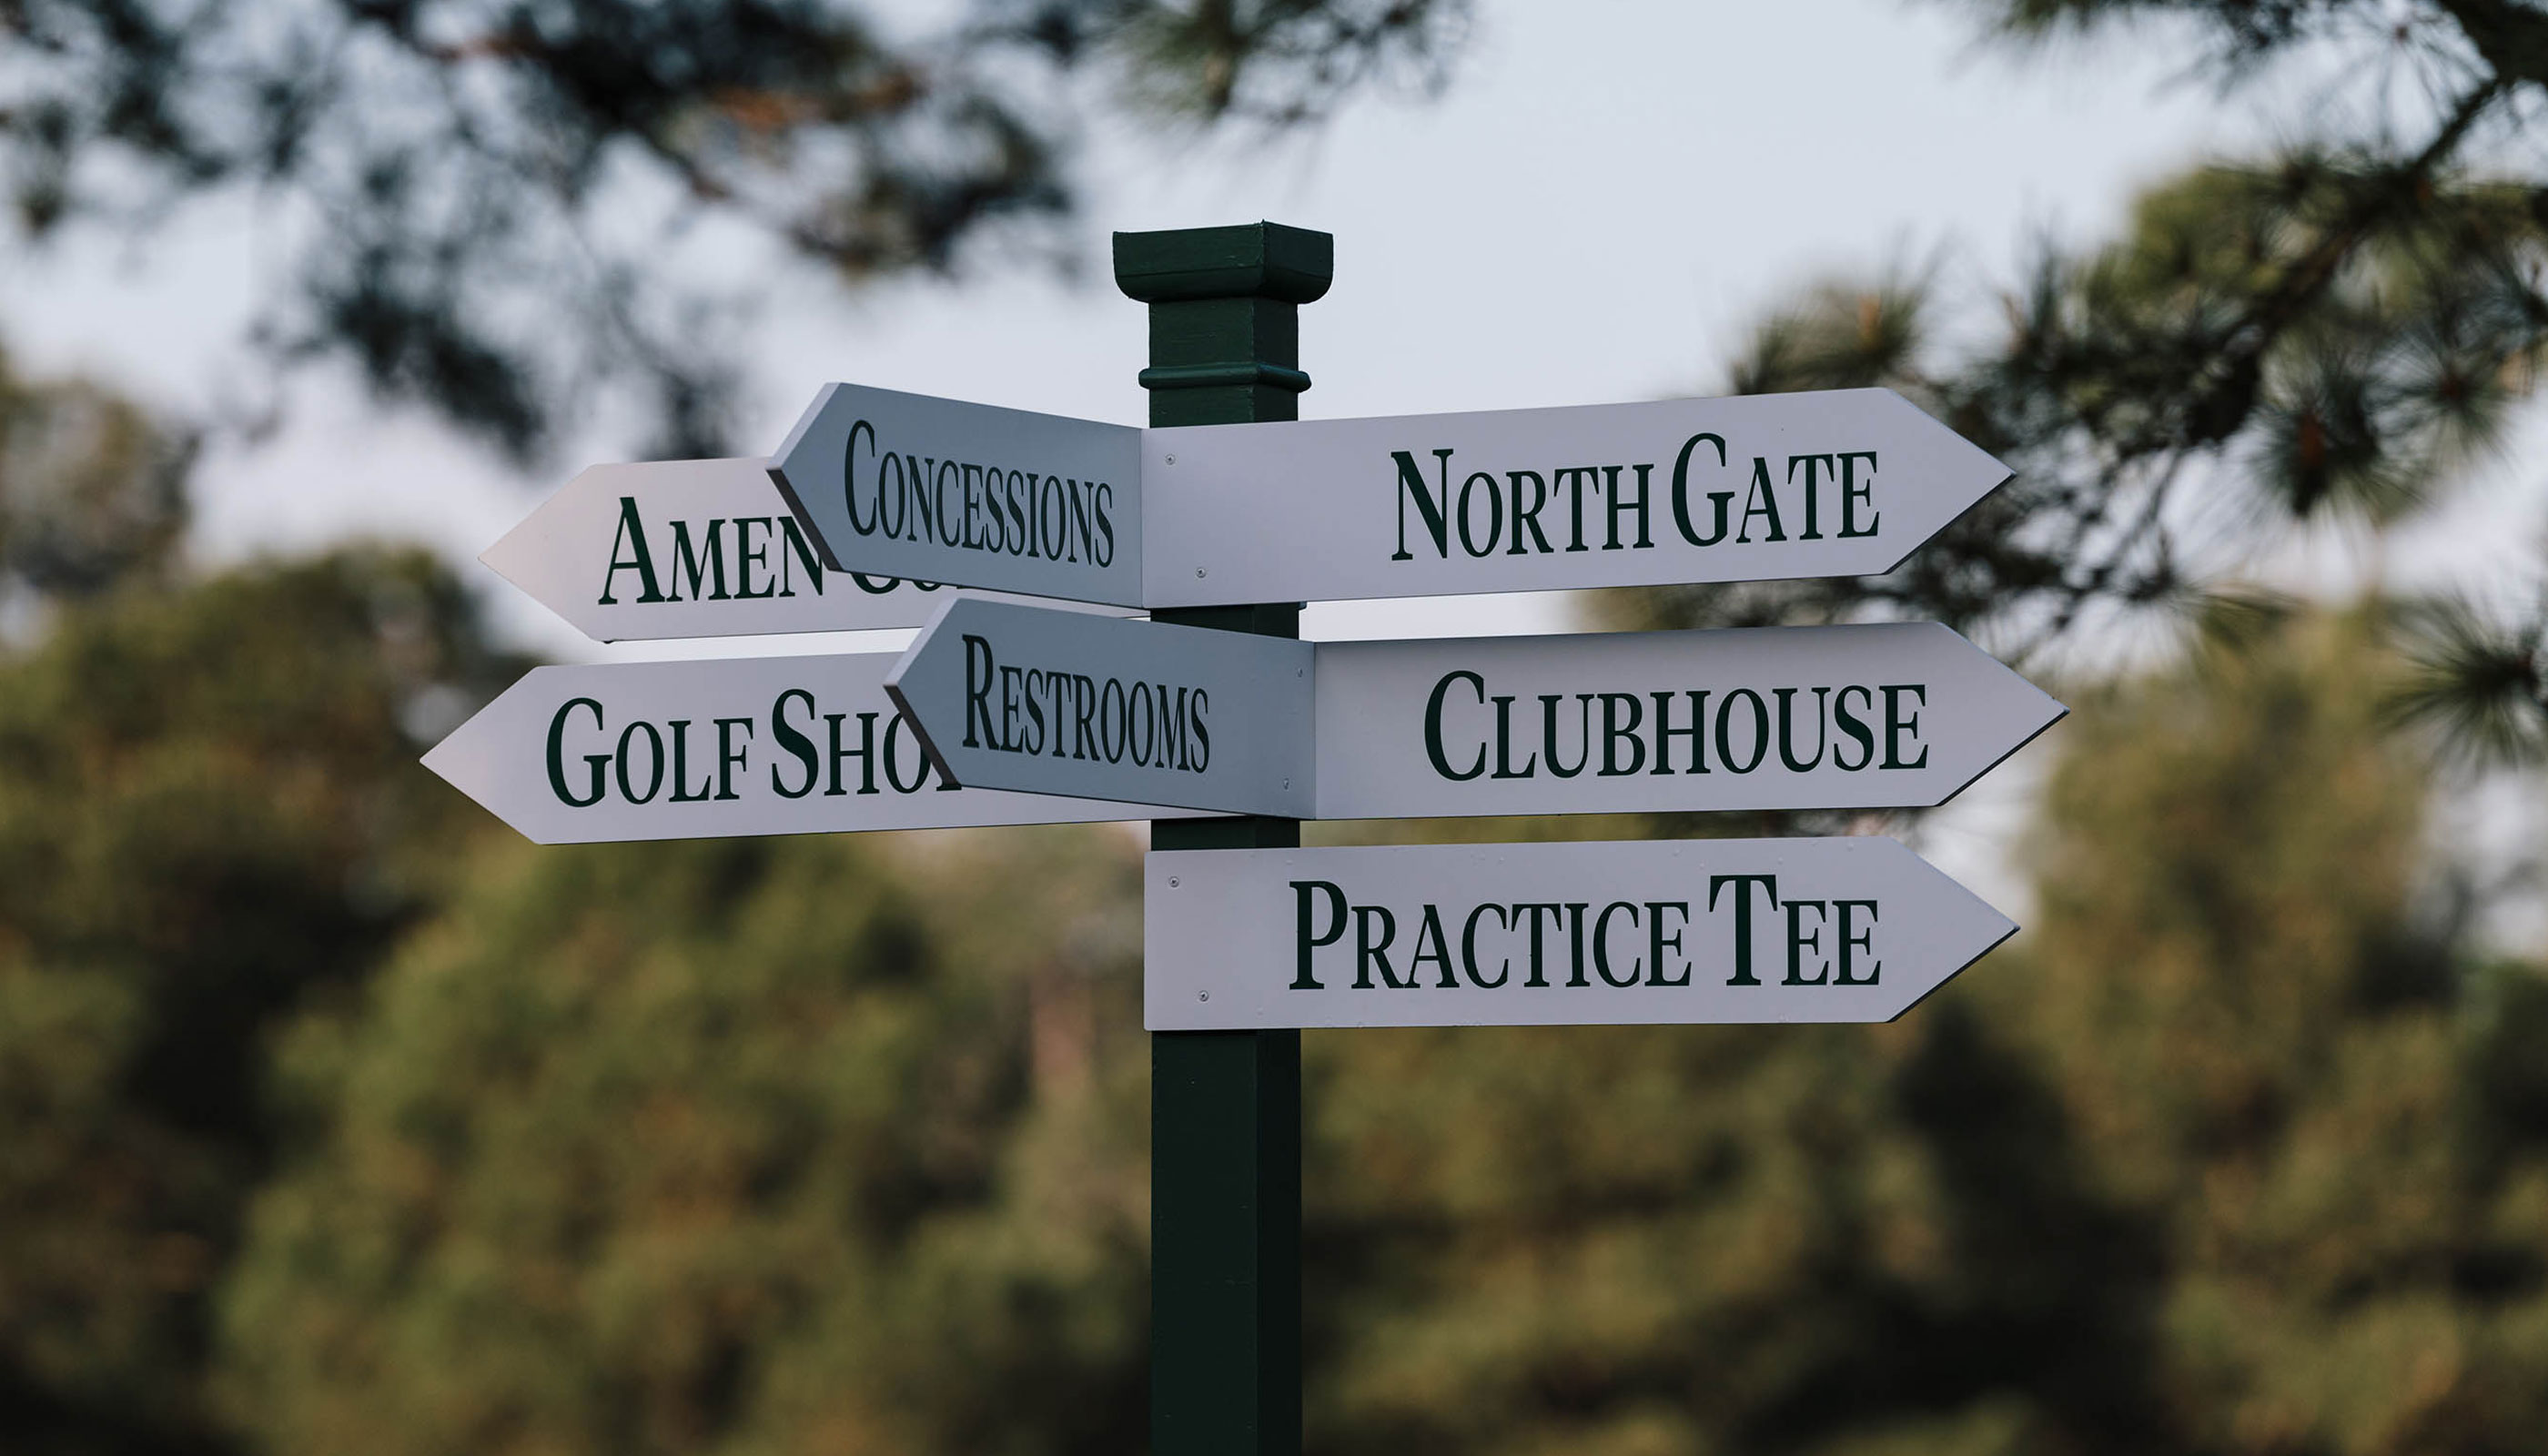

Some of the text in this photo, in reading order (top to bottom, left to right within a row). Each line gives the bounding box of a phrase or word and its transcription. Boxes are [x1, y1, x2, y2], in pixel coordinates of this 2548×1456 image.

[598, 496, 824, 605] AMEN
[844, 419, 1115, 569] CONCESSIONS
[1390, 432, 1880, 561] NORTH GATE
[546, 688, 962, 808] GOLF SHO
[961, 633, 1210, 774] RESTROOMS
[1424, 670, 1929, 782] CLUBHOUSE
[1289, 874, 1882, 991] PRACTICE TEE
